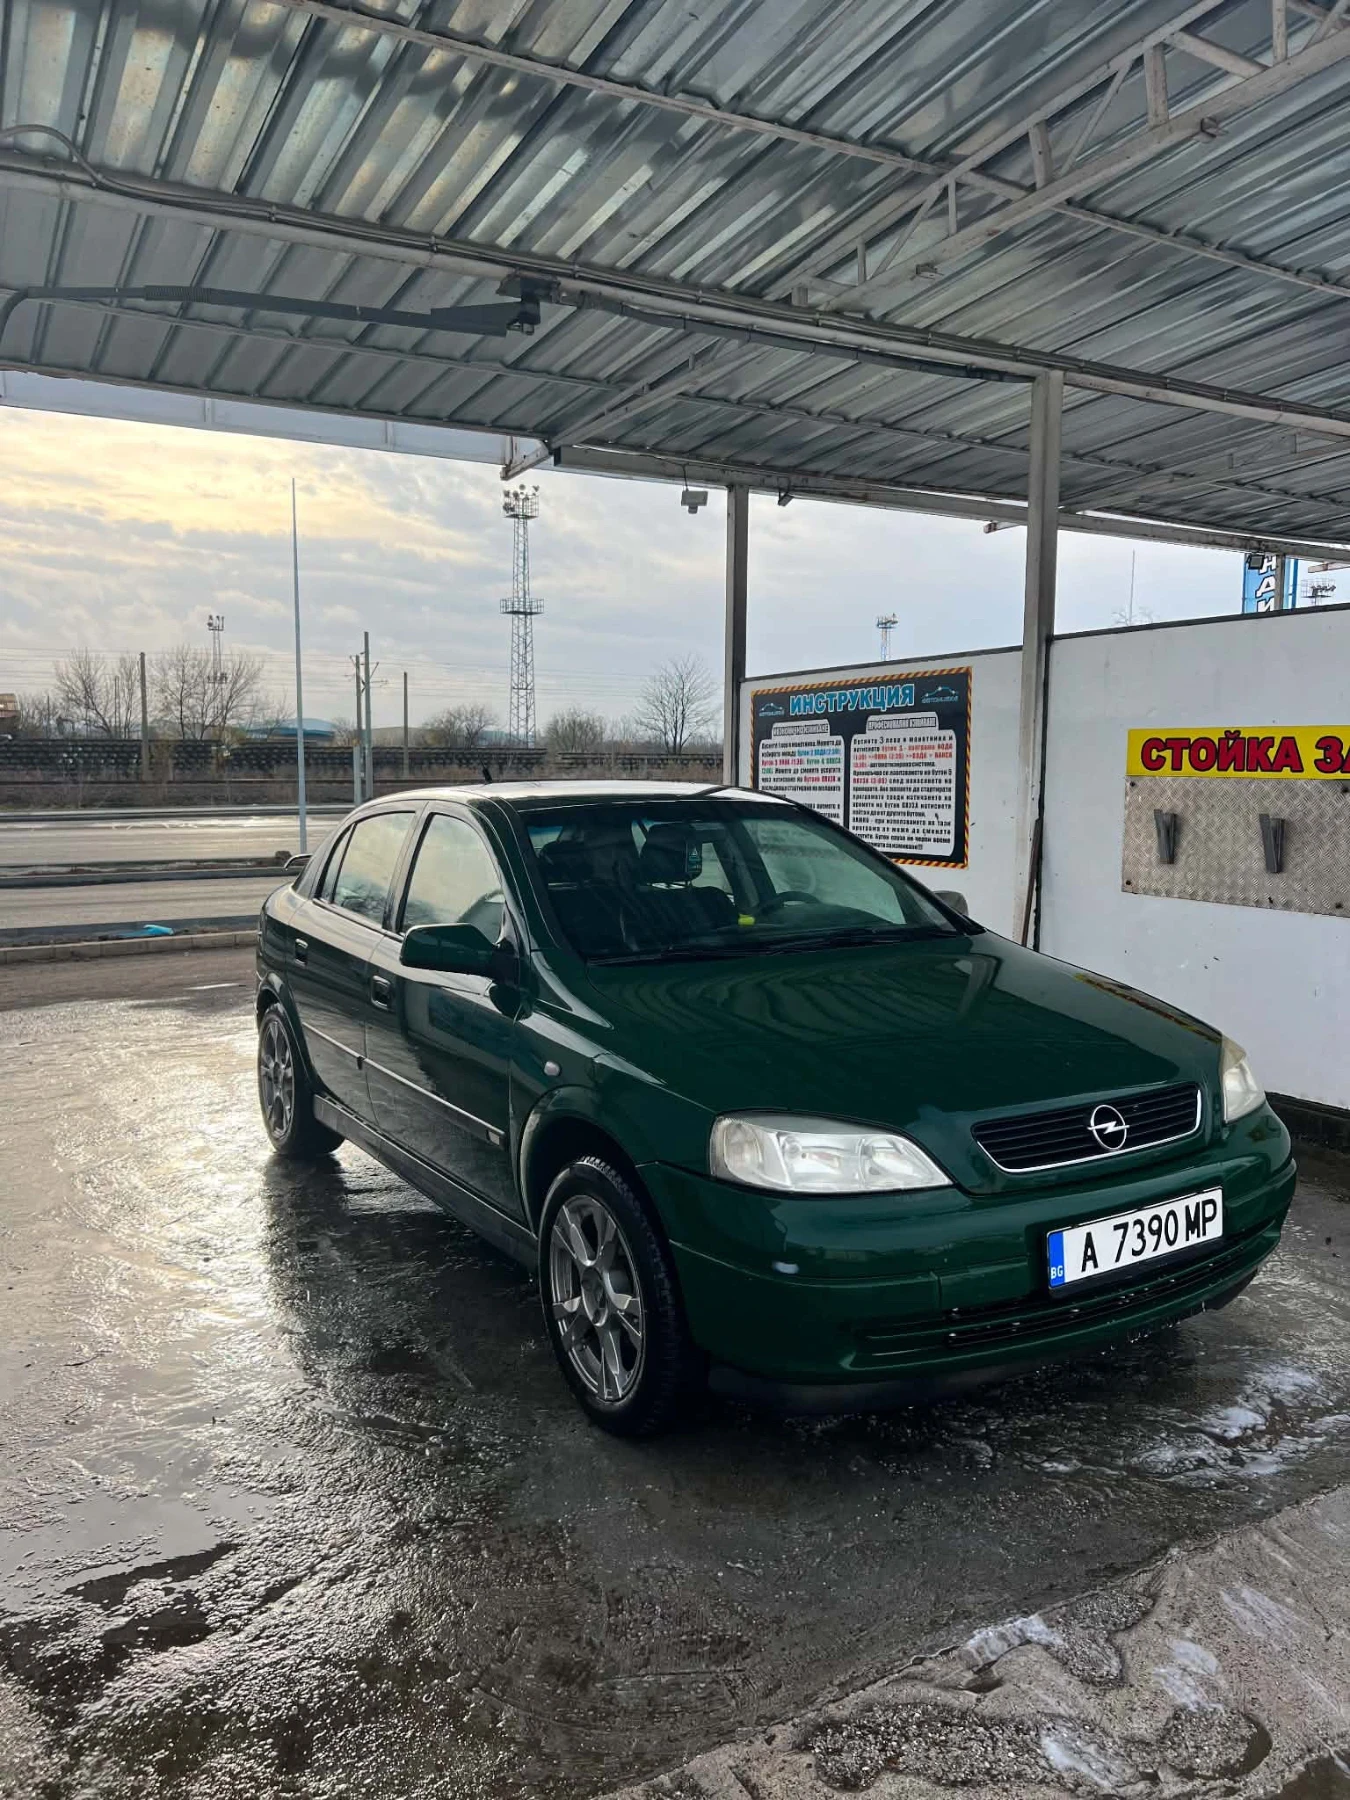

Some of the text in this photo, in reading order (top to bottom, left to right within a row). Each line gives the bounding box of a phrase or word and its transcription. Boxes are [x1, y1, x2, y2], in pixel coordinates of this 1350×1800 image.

[789, 684, 915, 716] ИНСТРУКЦИЯ
[1140, 730, 1350, 774] СТОЙКА З
[1081, 1199, 1217, 1272] A 7390 MP
[1050, 1265, 1063, 1280] BG
